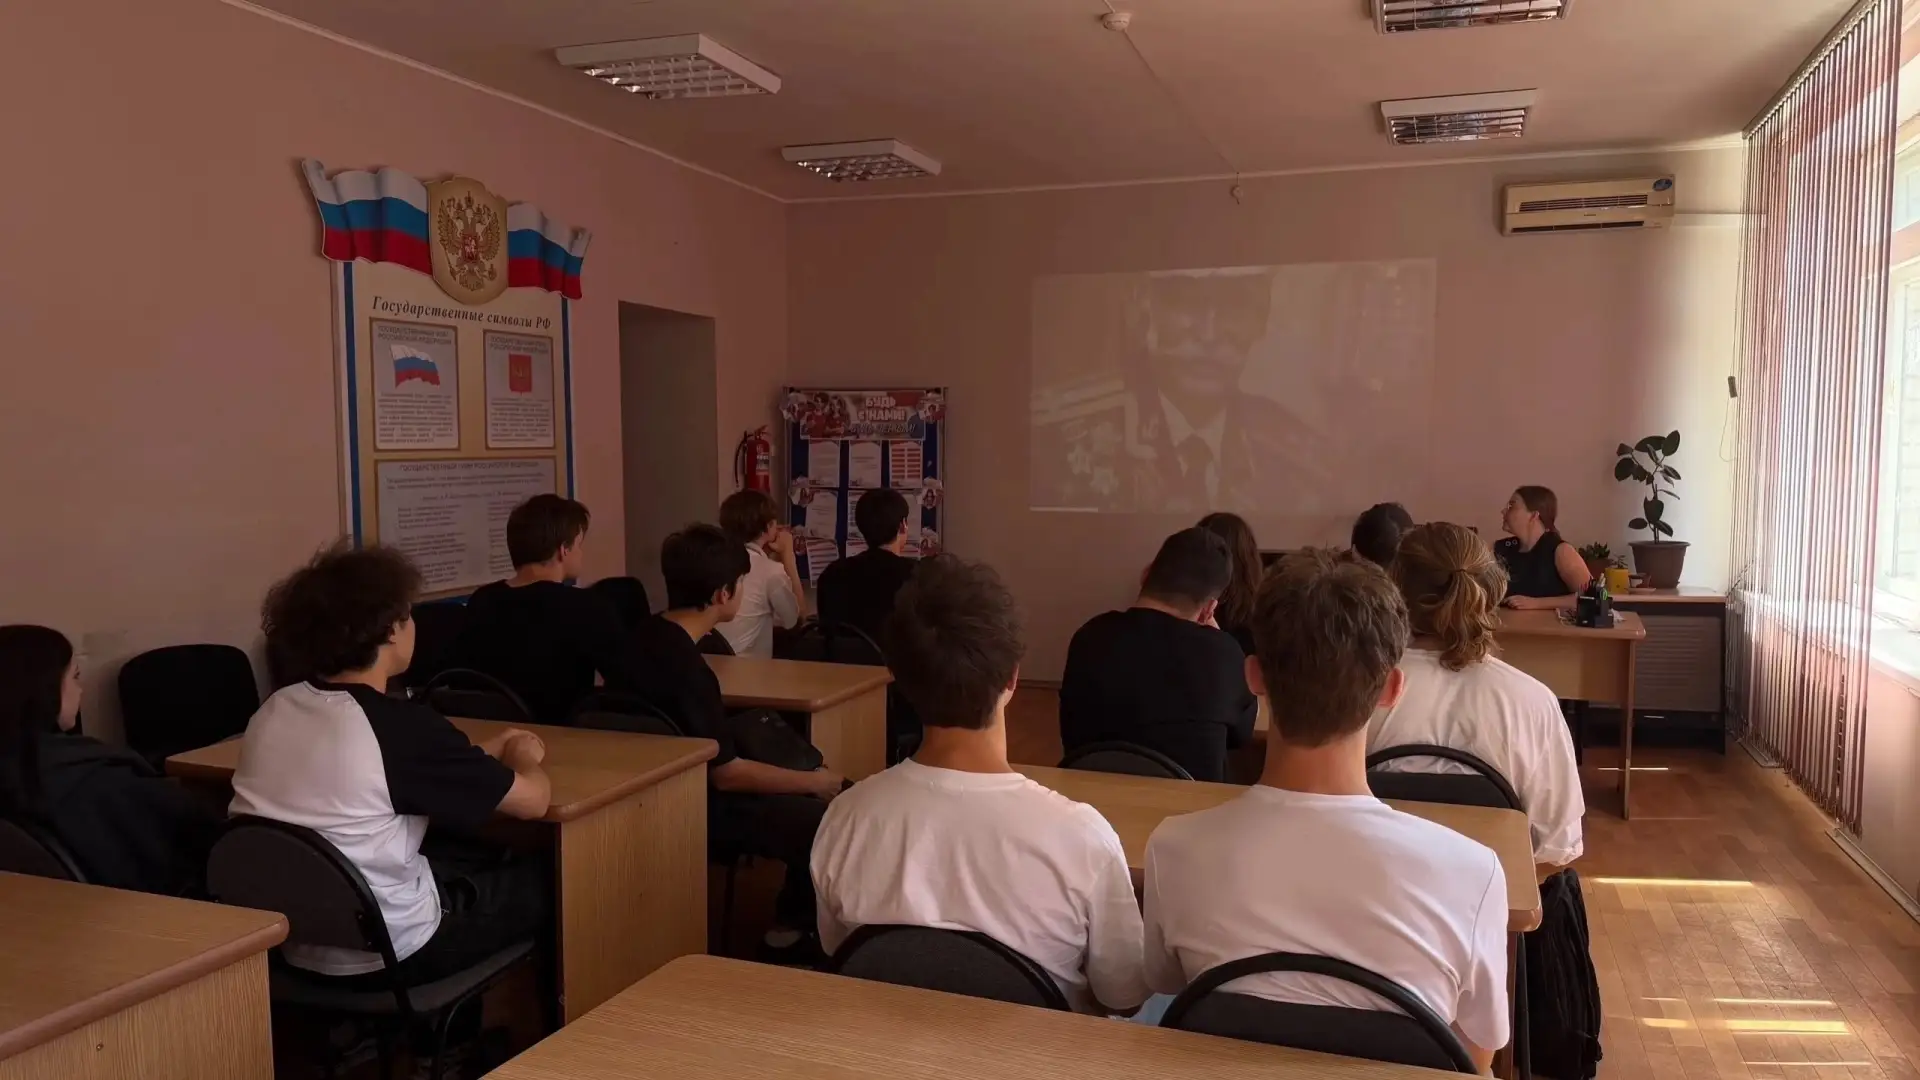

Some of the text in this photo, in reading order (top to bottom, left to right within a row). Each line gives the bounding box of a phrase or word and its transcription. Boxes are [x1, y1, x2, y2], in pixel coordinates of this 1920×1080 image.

[372, 296, 551, 330] Государственные символы РФ
[865, 395, 896, 409] БУДЬ
[869, 408, 905, 421] НАМИ!
